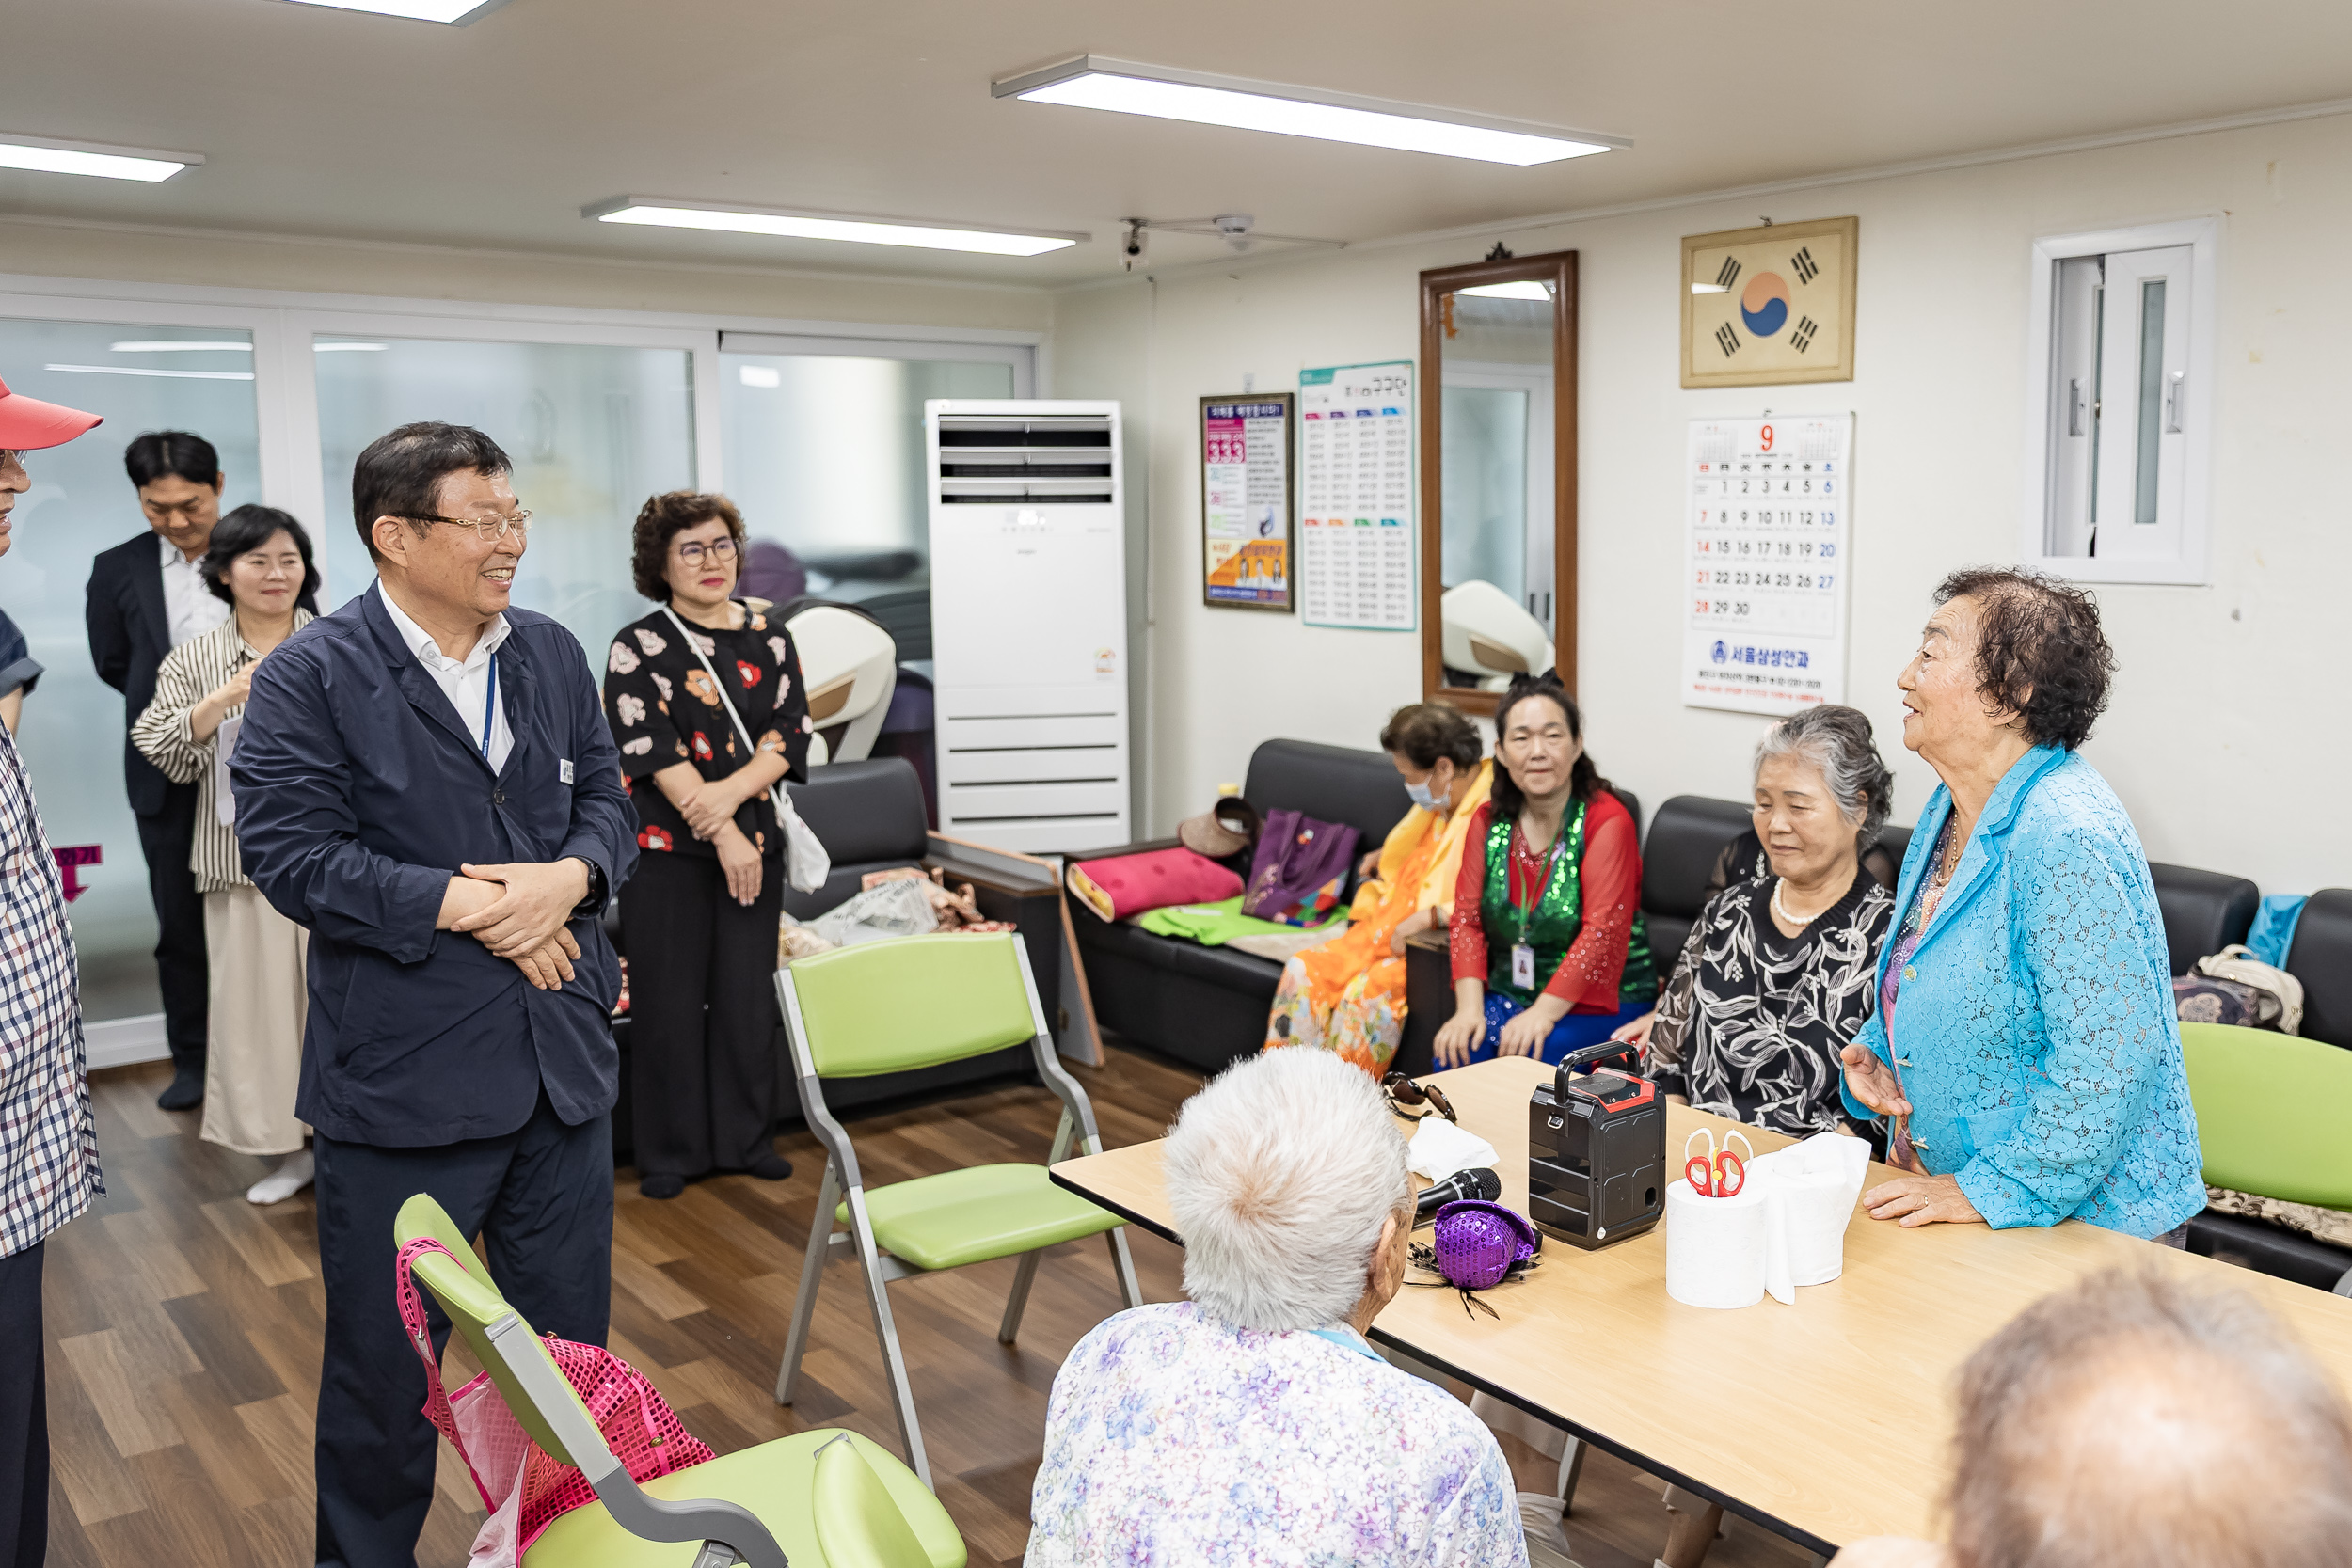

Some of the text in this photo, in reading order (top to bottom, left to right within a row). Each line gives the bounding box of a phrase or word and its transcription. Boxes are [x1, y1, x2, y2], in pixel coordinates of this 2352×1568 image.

[1761, 425, 1773, 451] 9
[1722, 479, 1728, 494] 1
[1740, 478, 1750, 494] 2
[1761, 478, 1771, 494] 3
[1802, 478, 1812, 494] 5
[1823, 480, 1834, 494] 6
[1700, 509, 1836, 526] 7 8 9 10 11 12 13
[1697, 539, 1836, 558] 14 15 16 17 18 19 20
[1696, 570, 1835, 590] 21 22 23 24 25 26 27
[1714, 600, 1729, 614] 29
[1733, 601, 1751, 616] 30
[1732, 645, 1810, 669] 서울삼성안과
